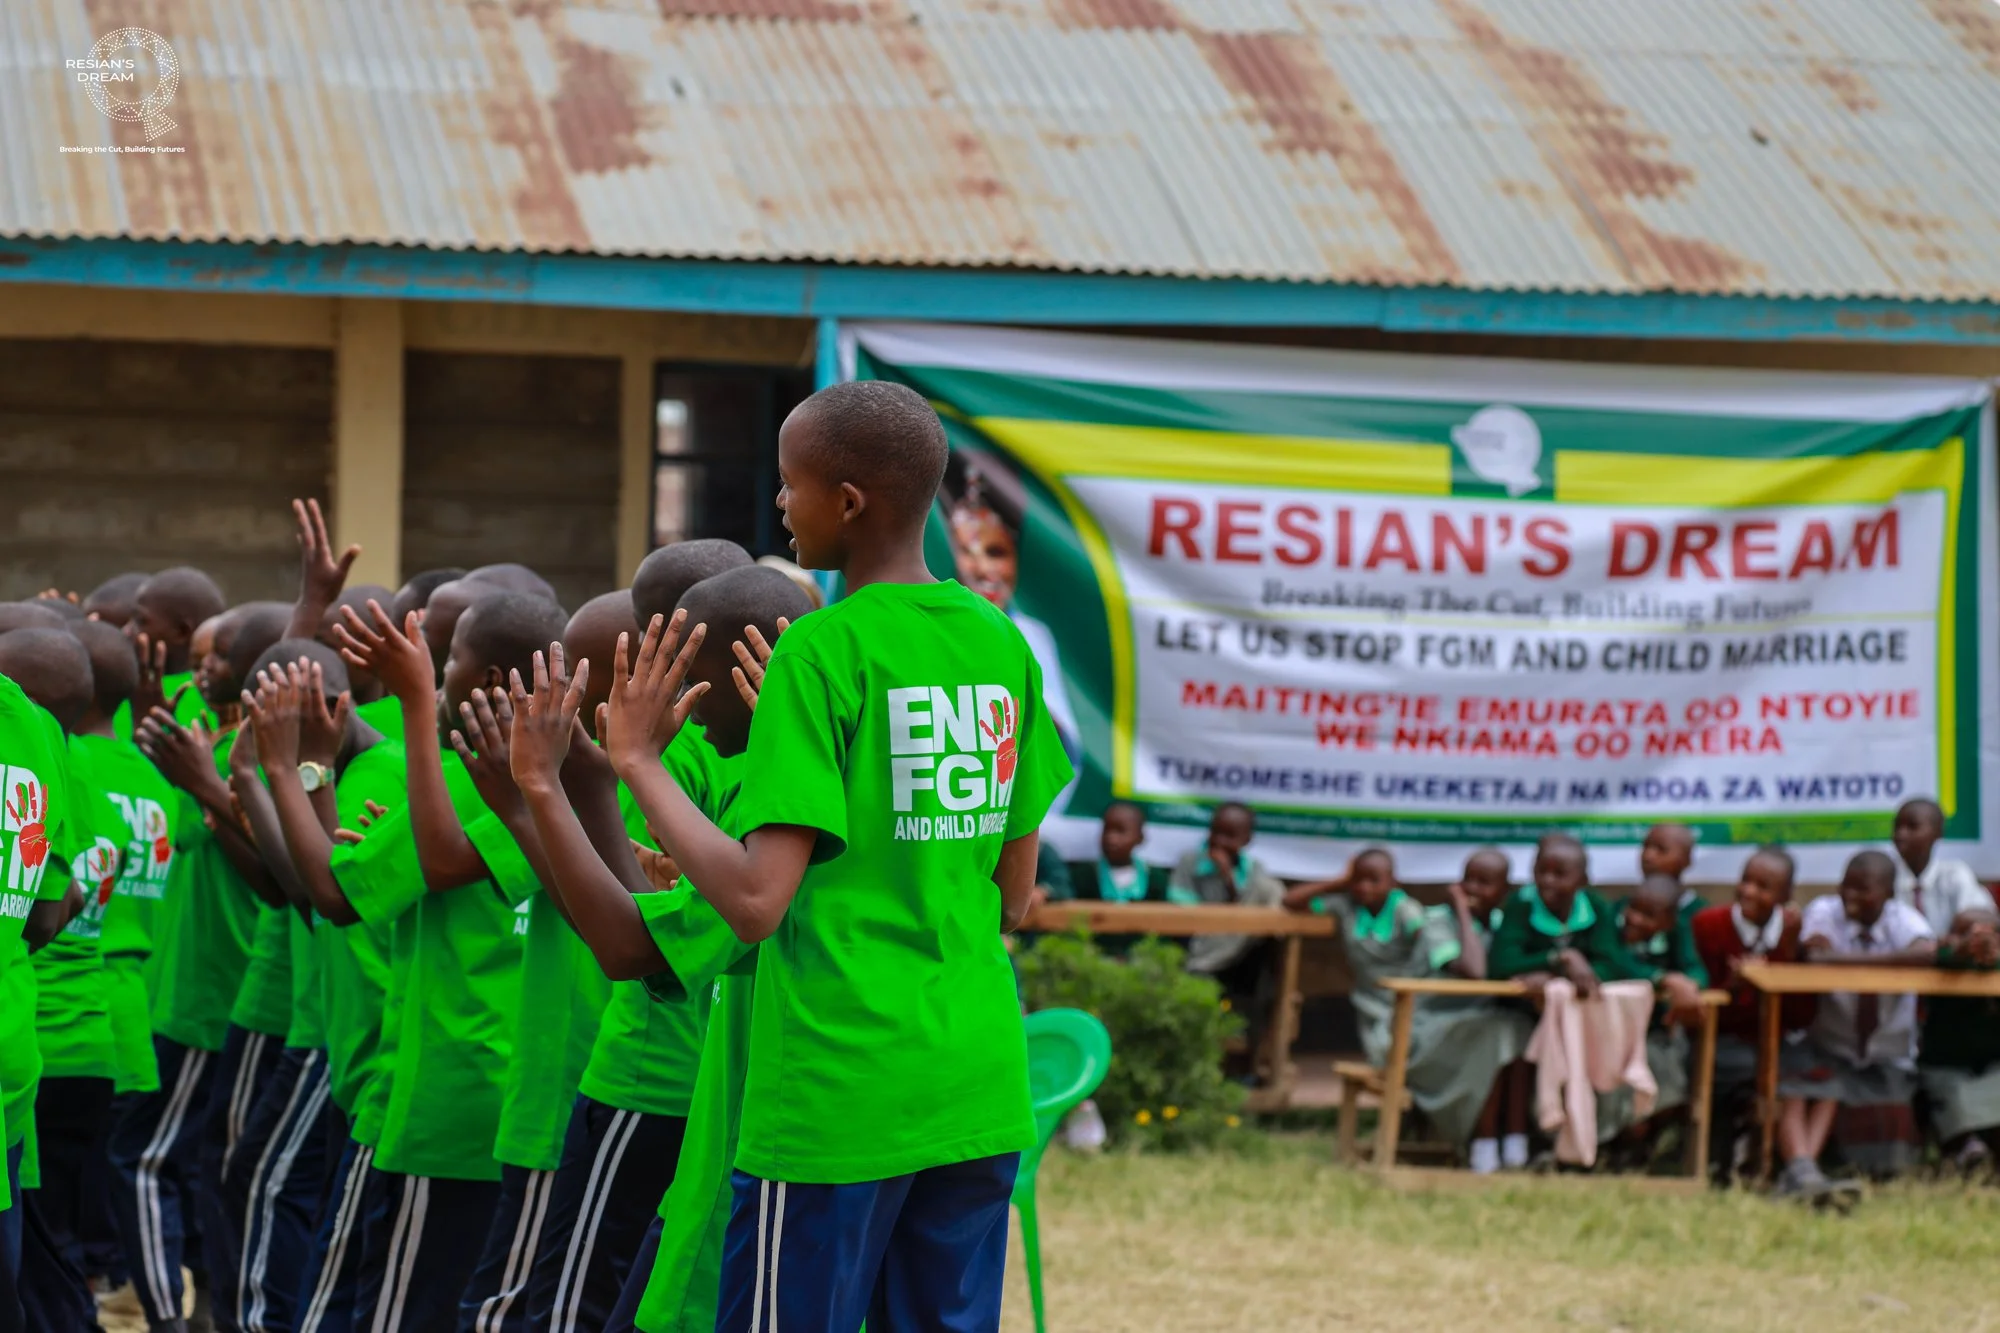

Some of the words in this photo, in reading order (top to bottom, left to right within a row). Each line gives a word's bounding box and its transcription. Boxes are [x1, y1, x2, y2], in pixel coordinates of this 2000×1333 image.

[1606, 508, 1901, 581] DREAM
[1155, 619, 1224, 654] LET
[1240, 624, 1290, 658] US
[1305, 630, 1402, 663] STOP
[1416, 635, 1497, 667] FGM
[1510, 640, 1589, 671] AND
[1601, 641, 1710, 673] CHILD
[1722, 630, 1908, 671] MARRIAGE
[887, 684, 1014, 755] END
[1457, 696, 1669, 728] EMURATA
[1684, 695, 1740, 727] OO
[1758, 688, 1920, 721] NTOYIE
[1316, 722, 1376, 750] WE
[1394, 727, 1559, 758] NKIAMA
[1573, 731, 1631, 759] OO
[1644, 726, 1784, 757] NKERA
[1157, 757, 1364, 796] TUKOMESHE
[1375, 773, 1557, 803] UKEKETAJI
[1568, 779, 1605, 802] NA
[1618, 777, 1711, 801] NDOA
[1721, 775, 1764, 799] ZA
[1776, 773, 1905, 798] WATOTO
[894, 816, 932, 841] AND
[935, 814, 975, 841] CHILD
